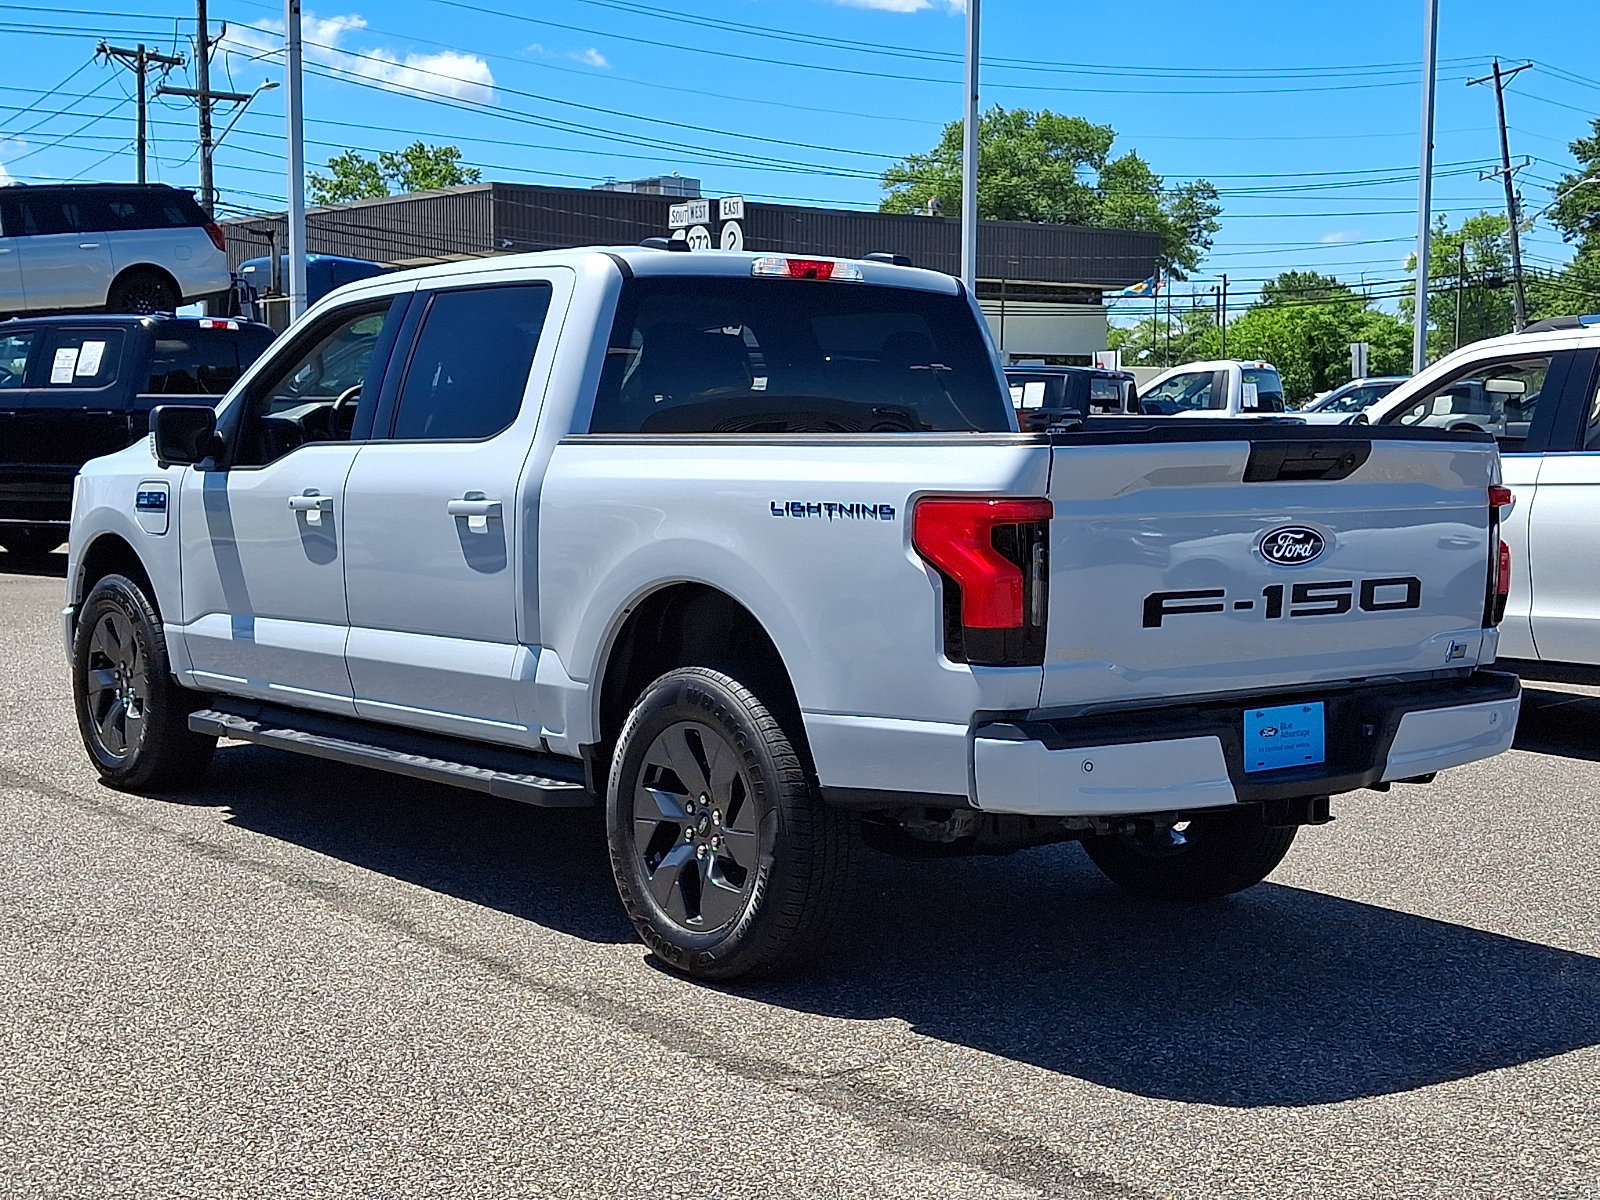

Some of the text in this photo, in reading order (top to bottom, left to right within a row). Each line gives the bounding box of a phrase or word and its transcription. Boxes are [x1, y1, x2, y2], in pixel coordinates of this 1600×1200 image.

[671, 209, 688, 223] SOUT
[690, 205, 706, 219] WEST
[723, 201, 740, 215] EAST
[770, 501, 896, 523] LIGHTNING
[1272, 532, 1315, 558] Ford
[1142, 576, 1422, 628] F-150
